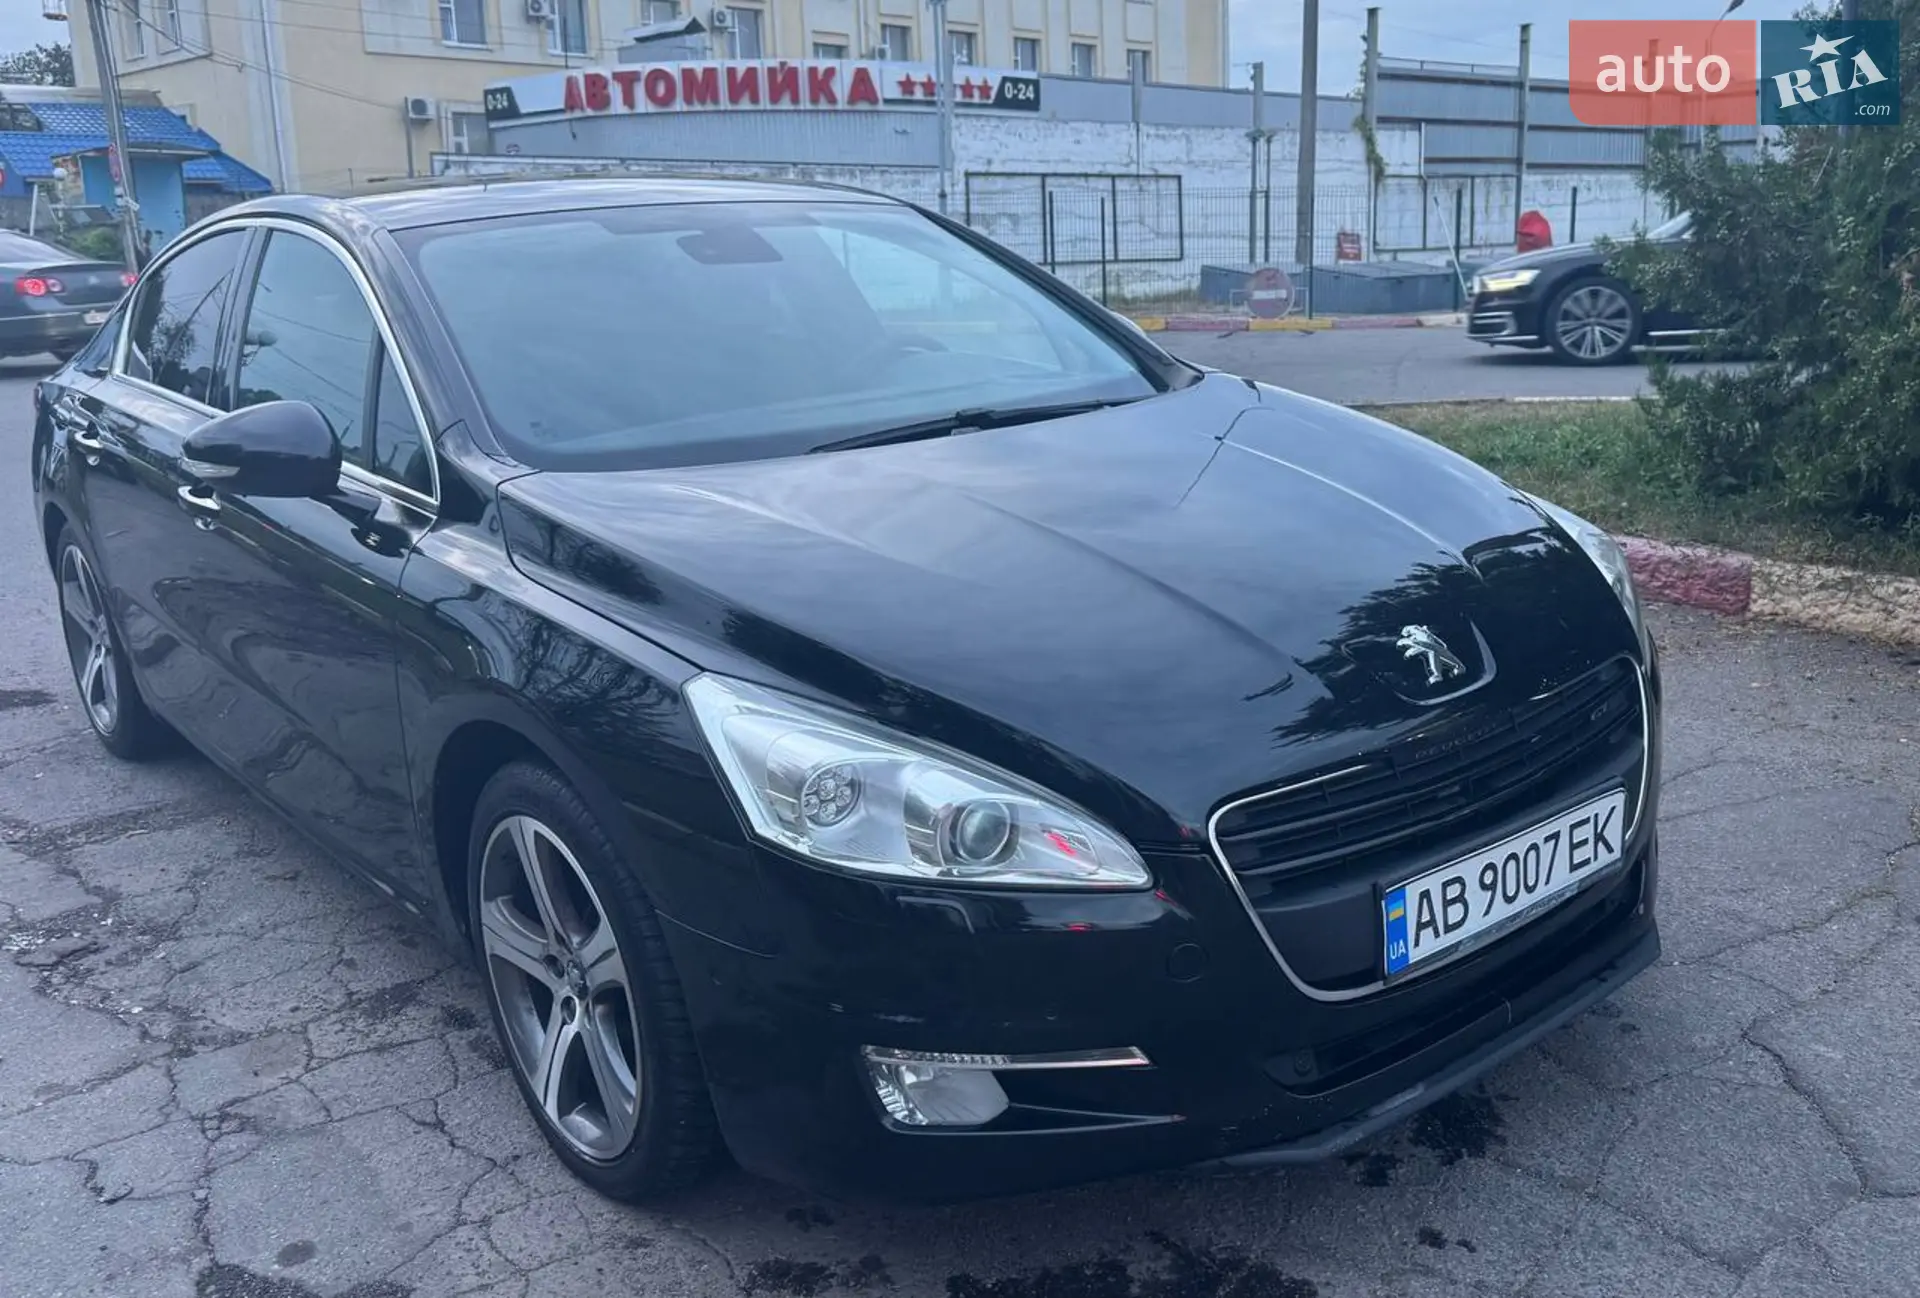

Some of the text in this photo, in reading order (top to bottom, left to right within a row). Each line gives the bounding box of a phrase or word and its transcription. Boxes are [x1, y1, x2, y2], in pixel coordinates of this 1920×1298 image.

[563, 61, 880, 113] АВТОМИЙКА
[1004, 81, 1035, 100] 0-24
[1412, 875, 1470, 949] AB
[1478, 830, 1561, 918] 9007
[1568, 805, 1617, 874] EK
[1389, 938, 1407, 960] UA
